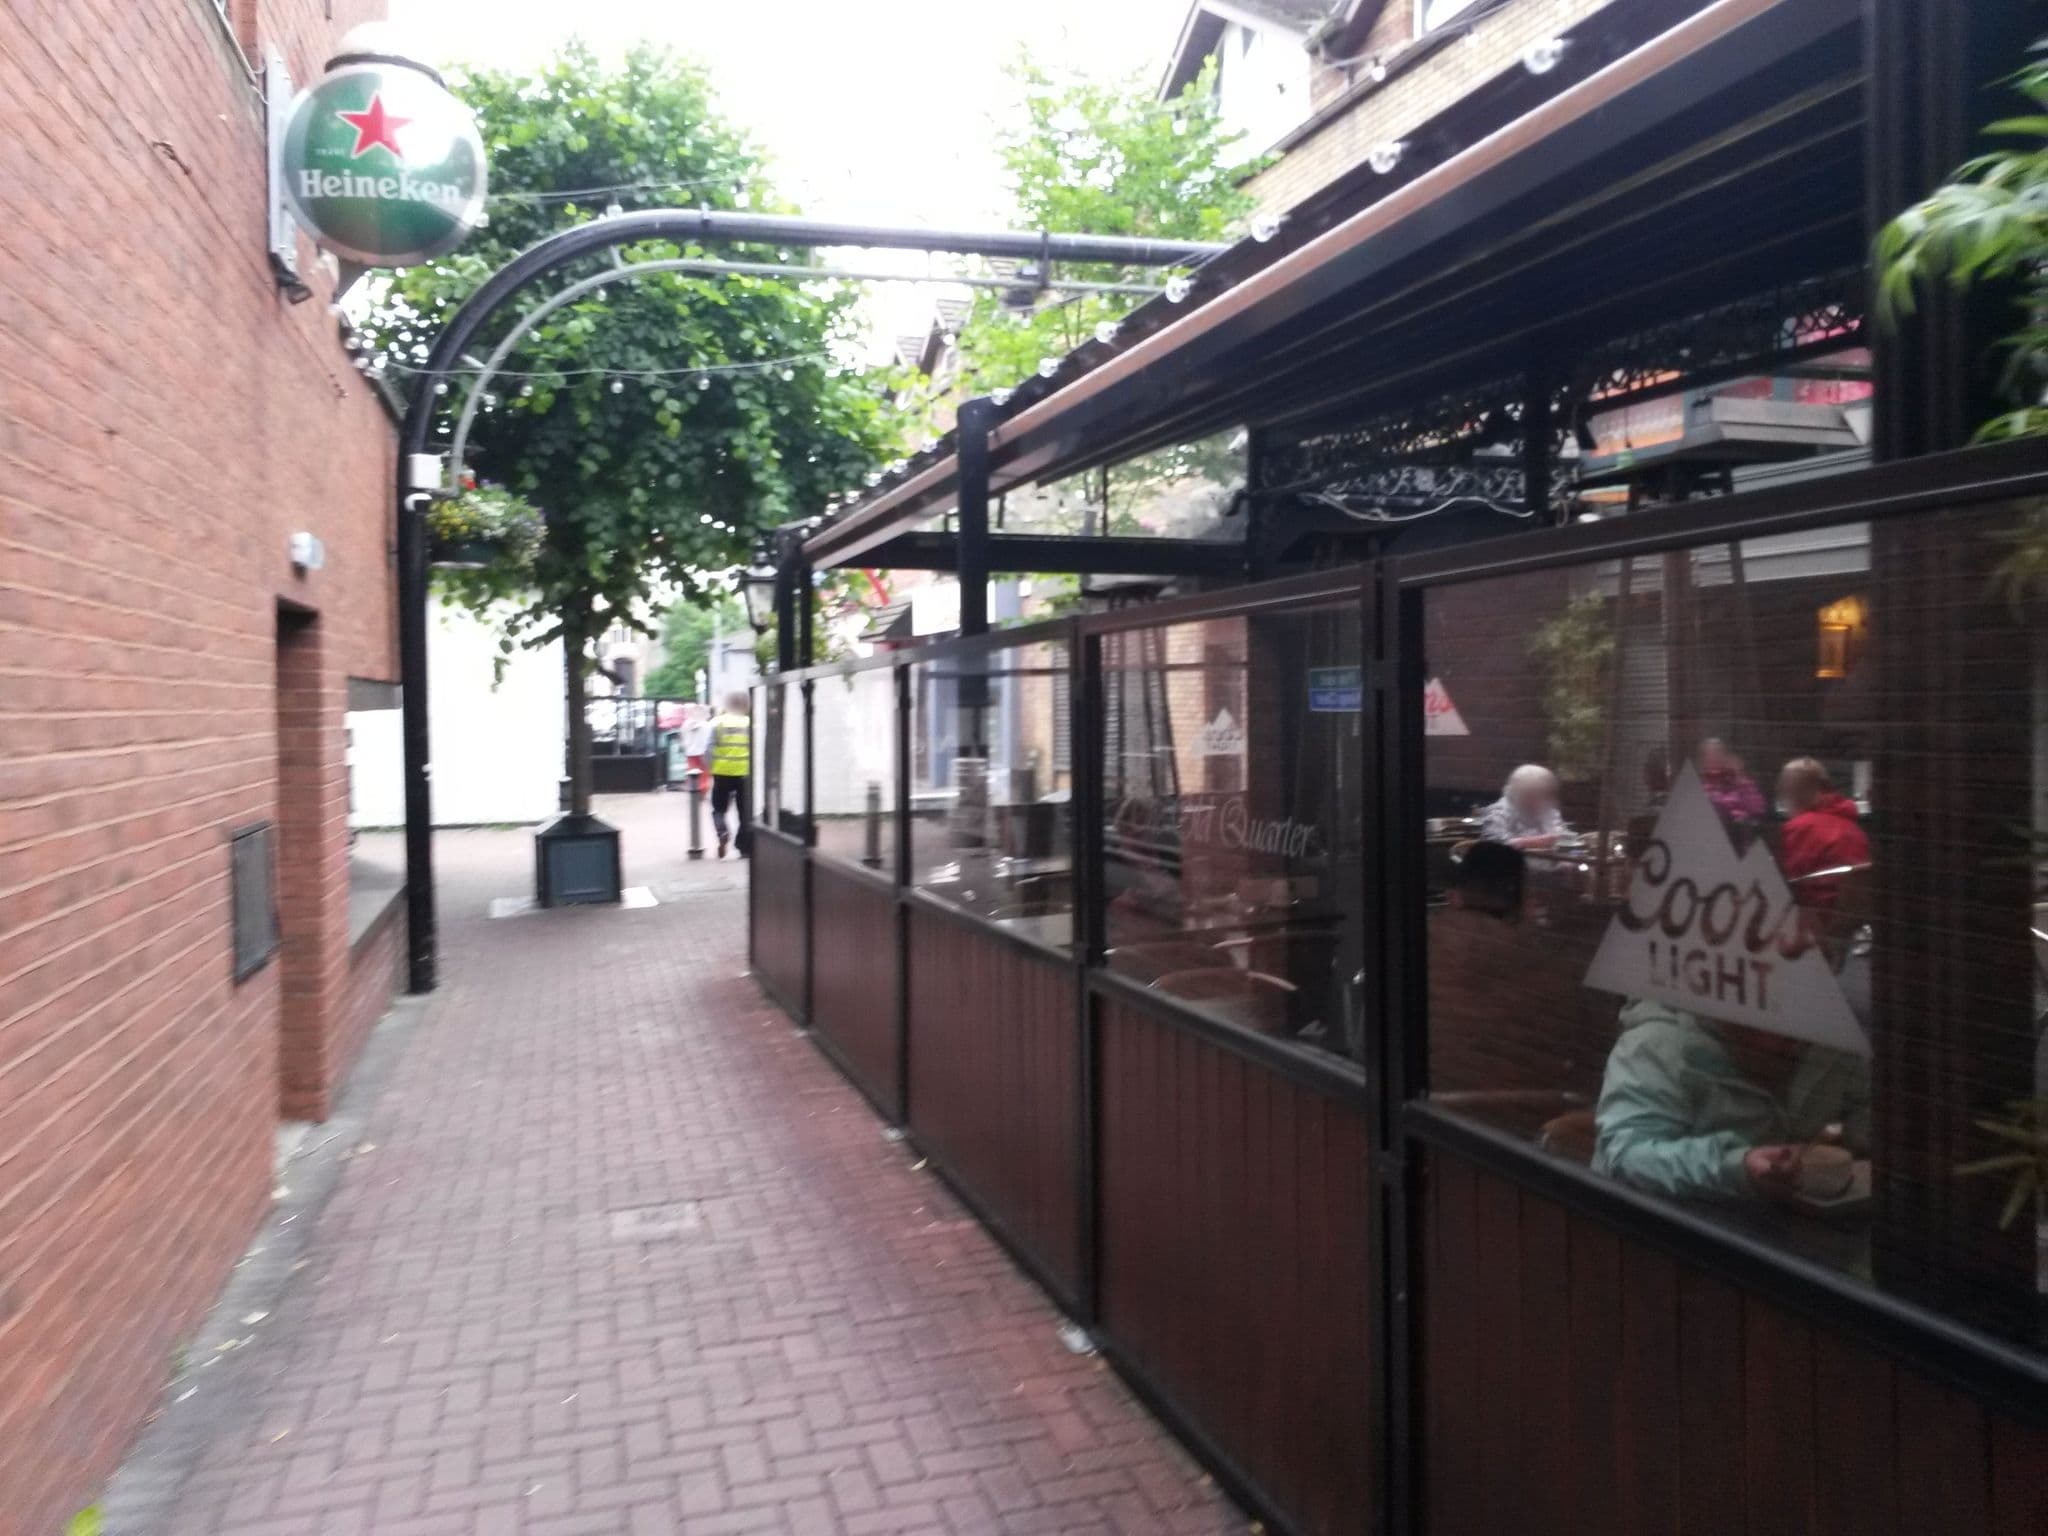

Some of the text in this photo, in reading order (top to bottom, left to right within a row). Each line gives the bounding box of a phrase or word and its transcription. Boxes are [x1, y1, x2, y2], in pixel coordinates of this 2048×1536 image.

[299, 168, 461, 201] Heineken
[1219, 797, 1316, 858] Quarter
[1616, 839, 1814, 961] Coors
[1649, 941, 1774, 1011] LIGHT
